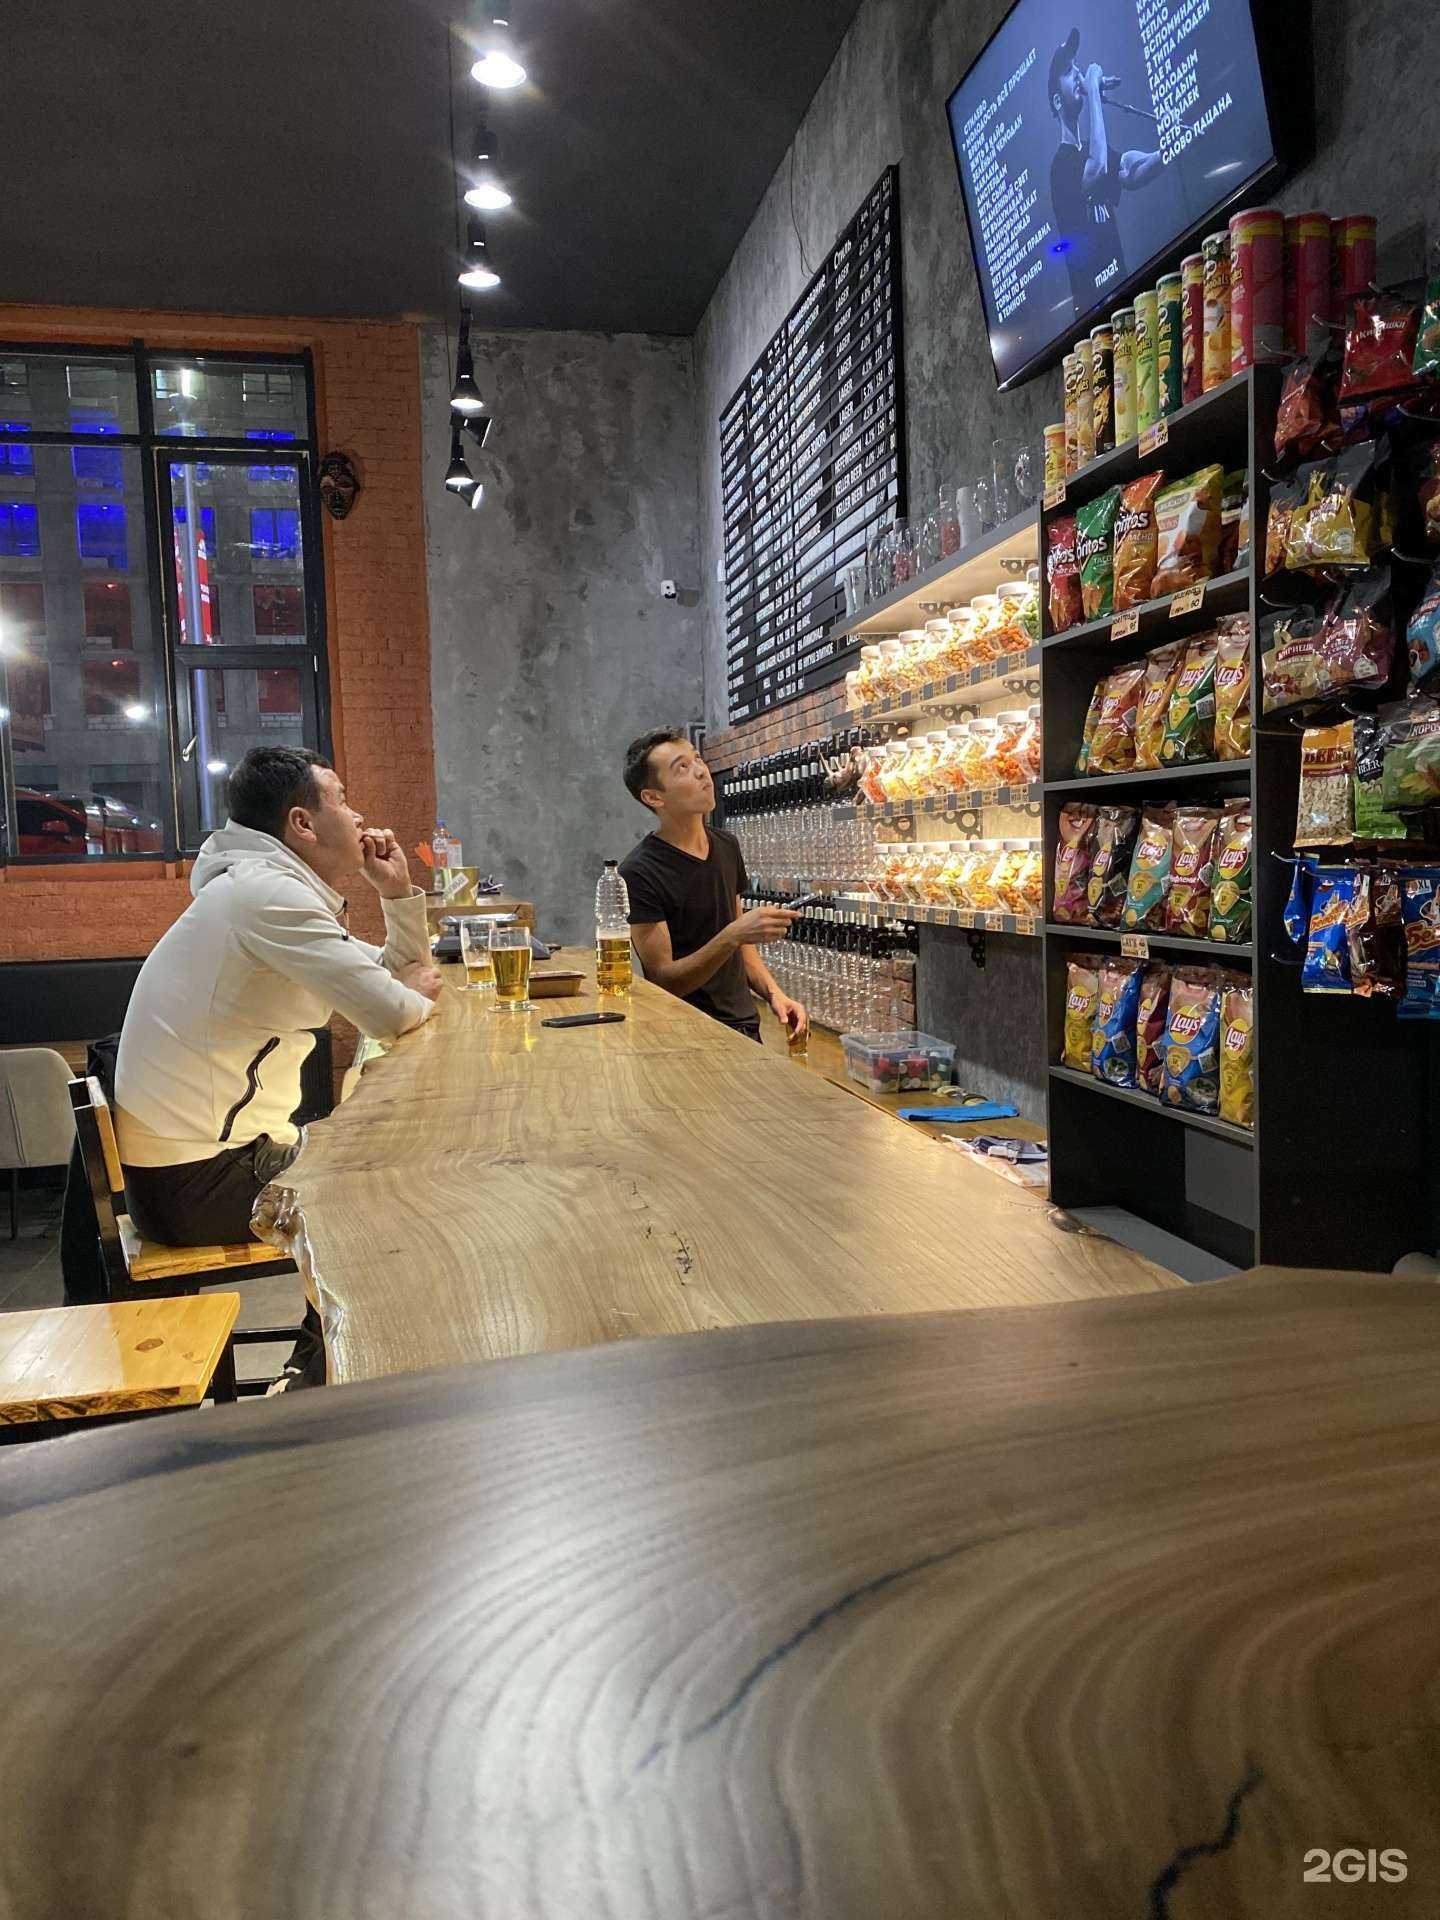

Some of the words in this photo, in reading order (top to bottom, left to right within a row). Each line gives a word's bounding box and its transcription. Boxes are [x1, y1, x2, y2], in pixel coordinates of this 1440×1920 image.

[1141, 7, 1168, 43] ТЕПЛО
[1146, 61, 1153, 76] 2
[1153, 38, 1176, 68] ТИПА
[1149, 66, 1164, 92] ГДЕ
[1165, 58, 1172, 75] Я
[1152, 48, 1198, 106] МОЛОДЫМ
[1154, 92, 1174, 120] ТАЕТ
[1175, 69, 1197, 102] ДЫМ
[1160, 124, 1181, 150] СЕТЬ
[1162, 130, 1193, 165] СЛОВО
[1193, 92, 1233, 137] ПАЦАНА
[1019, 259, 1043, 289] КОЛЕНО
